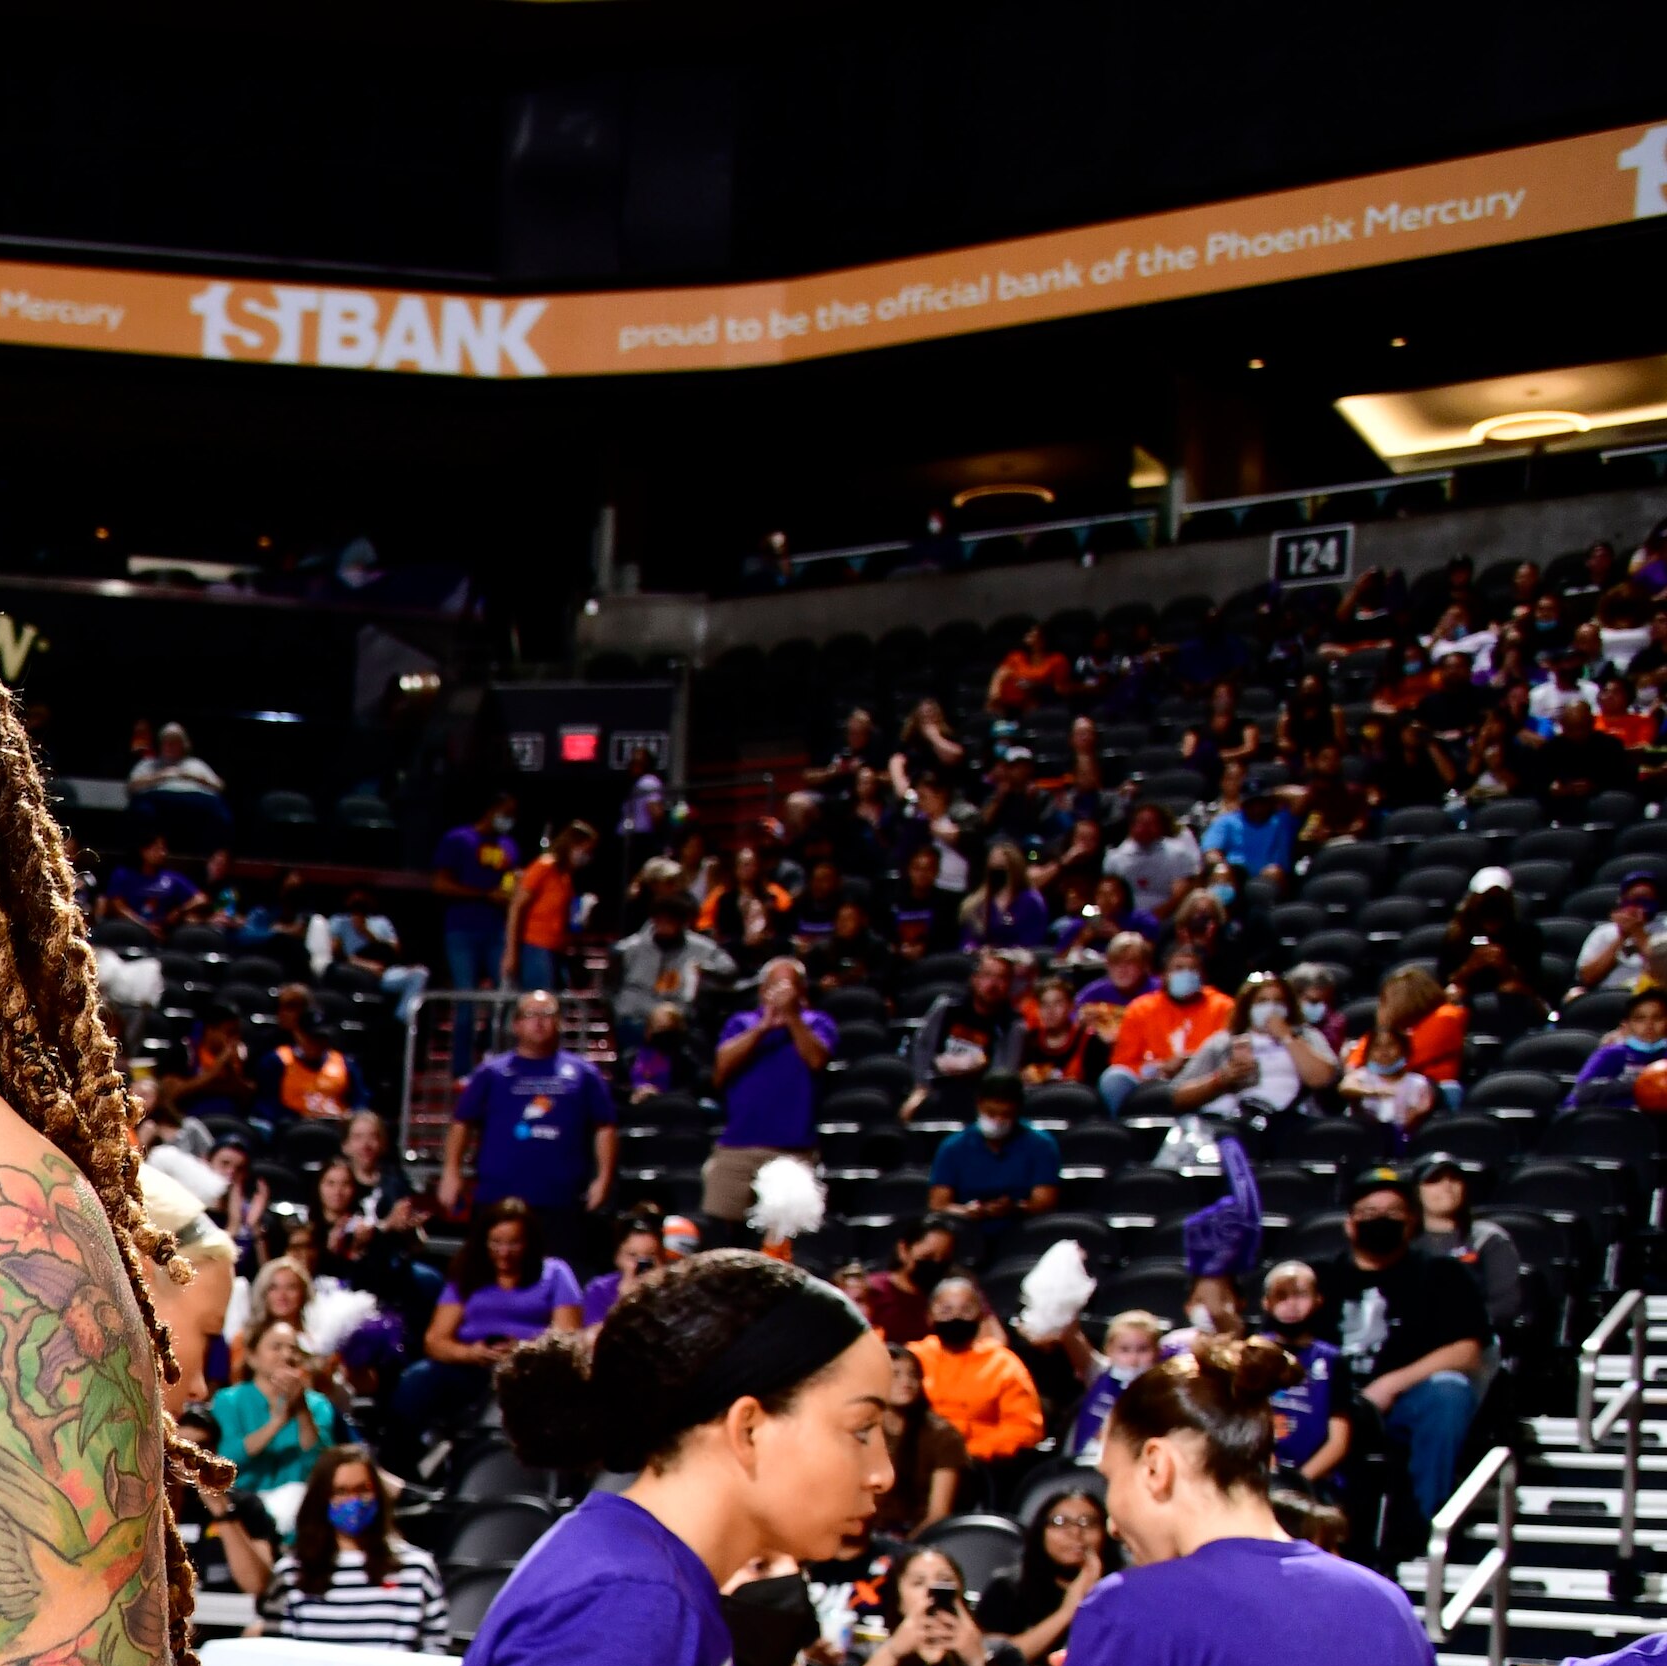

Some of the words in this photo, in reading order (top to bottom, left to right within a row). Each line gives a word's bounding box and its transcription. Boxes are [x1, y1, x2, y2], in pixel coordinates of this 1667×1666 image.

[618, 315, 718, 353] proud
[725, 316, 763, 343] to
[768, 308, 807, 340] be
[815, 300, 870, 332] the
[876, 276, 990, 322] official
[997, 260, 1083, 301] bank
[1090, 248, 1133, 284] of
[1137, 243, 1198, 277] the
[1205, 214, 1357, 266] Phoenix
[1364, 187, 1527, 239] Mercury
[0, 289, 126, 332] Mercury
[1287, 536, 1338, 575] 124
